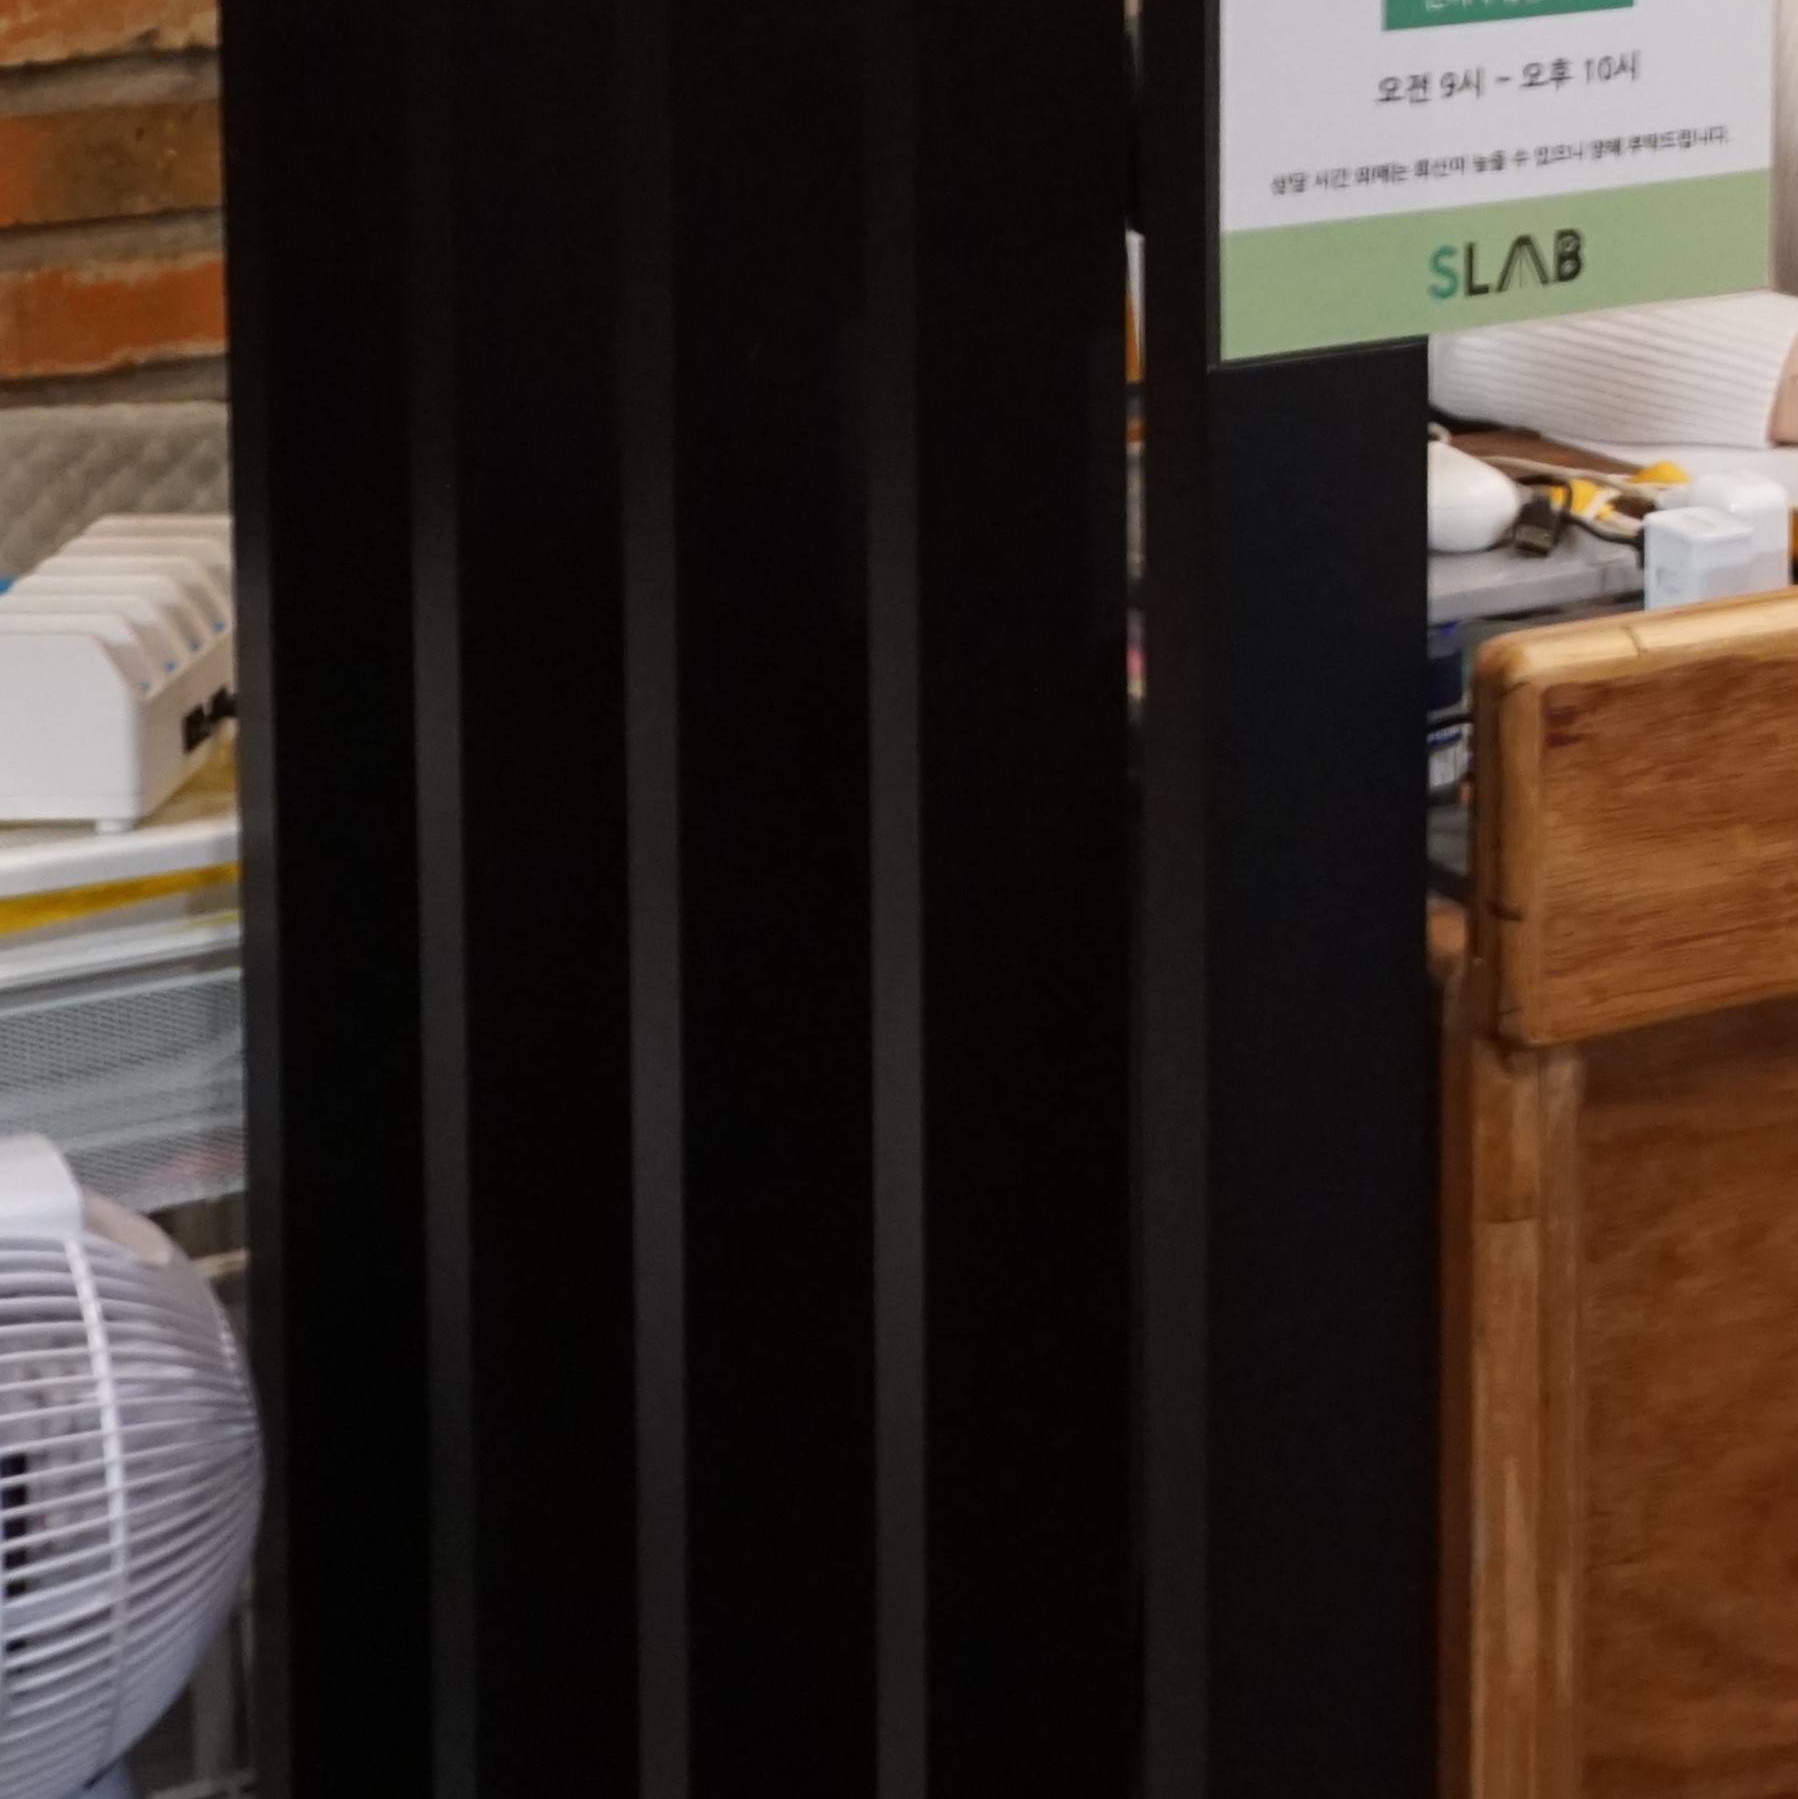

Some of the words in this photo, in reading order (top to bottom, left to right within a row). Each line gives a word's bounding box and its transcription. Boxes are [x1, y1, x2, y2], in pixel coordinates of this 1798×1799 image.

[1376, 71, 1432, 105] 오전
[1439, 65, 1485, 100] 9시
[1519, 57, 1573, 91] 오후
[1584, 49, 1642, 84] 10시
[1427, 227, 1584, 301] SLAB
